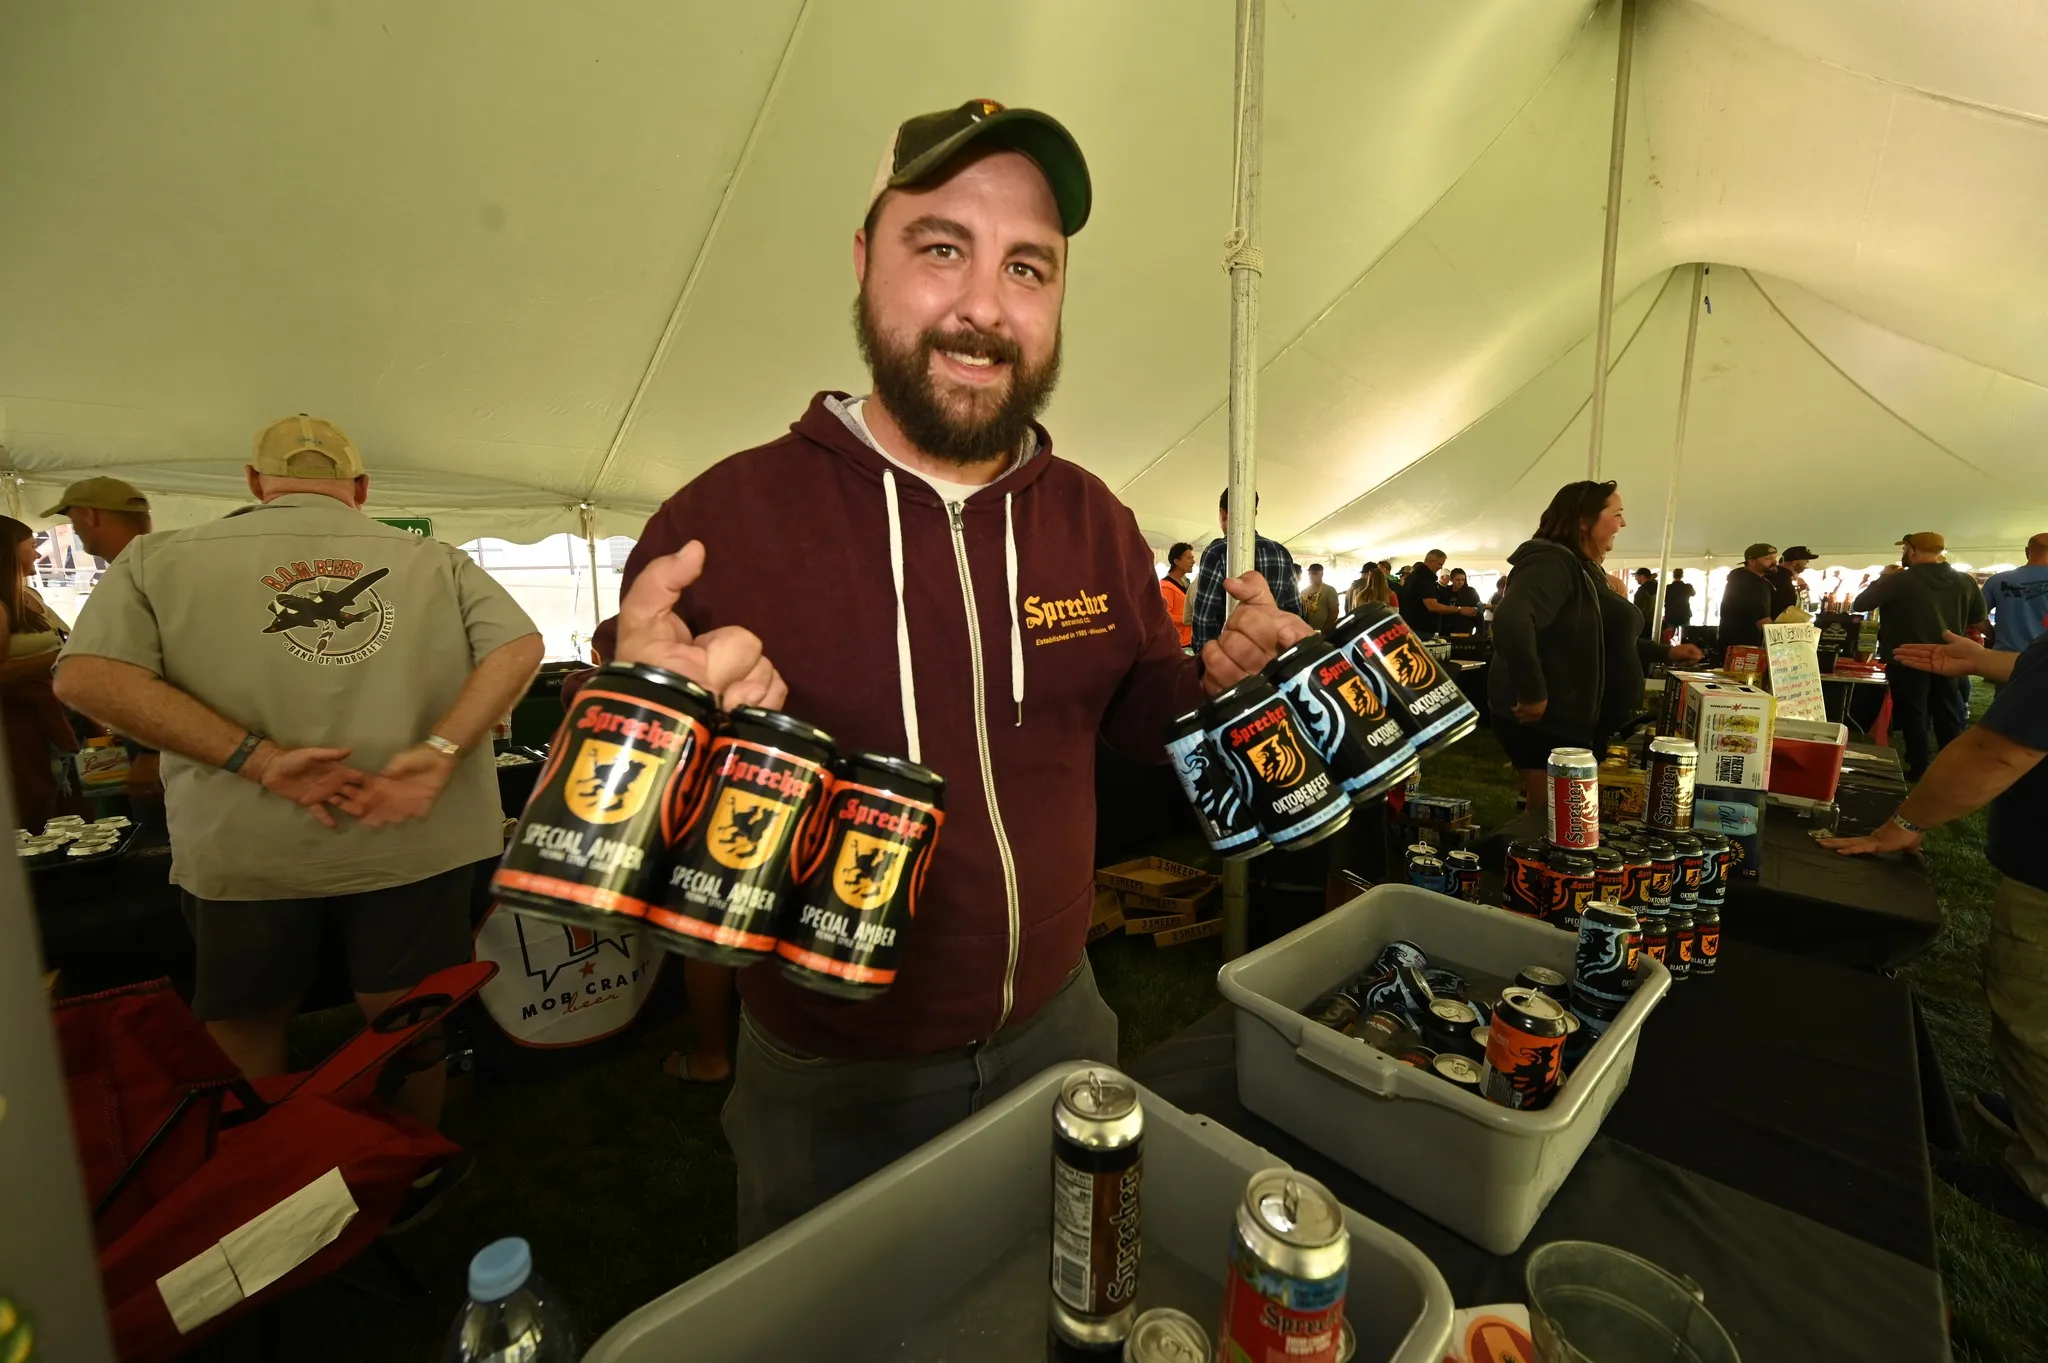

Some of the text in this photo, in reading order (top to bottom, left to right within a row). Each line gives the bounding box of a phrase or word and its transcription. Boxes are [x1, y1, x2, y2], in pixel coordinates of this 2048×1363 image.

[1024, 589, 1109, 629] Sprecher
[1061, 617, 1084, 628] BREWING
[288, 645, 314, 662] BAND
[336, 640, 382, 665] MOBCRAFT
[380, 605, 394, 640] BACKERS
[1036, 632, 1070, 646] Established
[576, 705, 686, 752] Sprecher
[1230, 704, 1287, 747] Sprecher
[716, 754, 812, 800] Sprecher
[1730, 755, 1744, 784] FREEDOM
[1272, 772, 1330, 815] OKTOBERFEST
[1564, 780, 1587, 844] Sprecher
[1653, 764, 1678, 826] Sprecher
[840, 798, 928, 840] Sprecher
[1718, 805, 1739, 830] Cold
[522, 823, 584, 856] SPECIAL
[586, 837, 644, 871] AMBER
[669, 865, 723, 899] SPECIAL
[726, 882, 776, 912] AMBER
[1117, 876, 1144, 890] SHEEPS
[1156, 859, 1200, 879] 3 SHEEPS
[800, 904, 897, 947] SPECIAL AMBER
[1150, 916, 1180, 927] SHEEPS
[1179, 924, 1212, 939] SHEEPS
[522, 962, 647, 1020] MOB CRAFT
[563, 991, 620, 1015] beer
[1106, 1171, 1140, 1303] Sprecher
